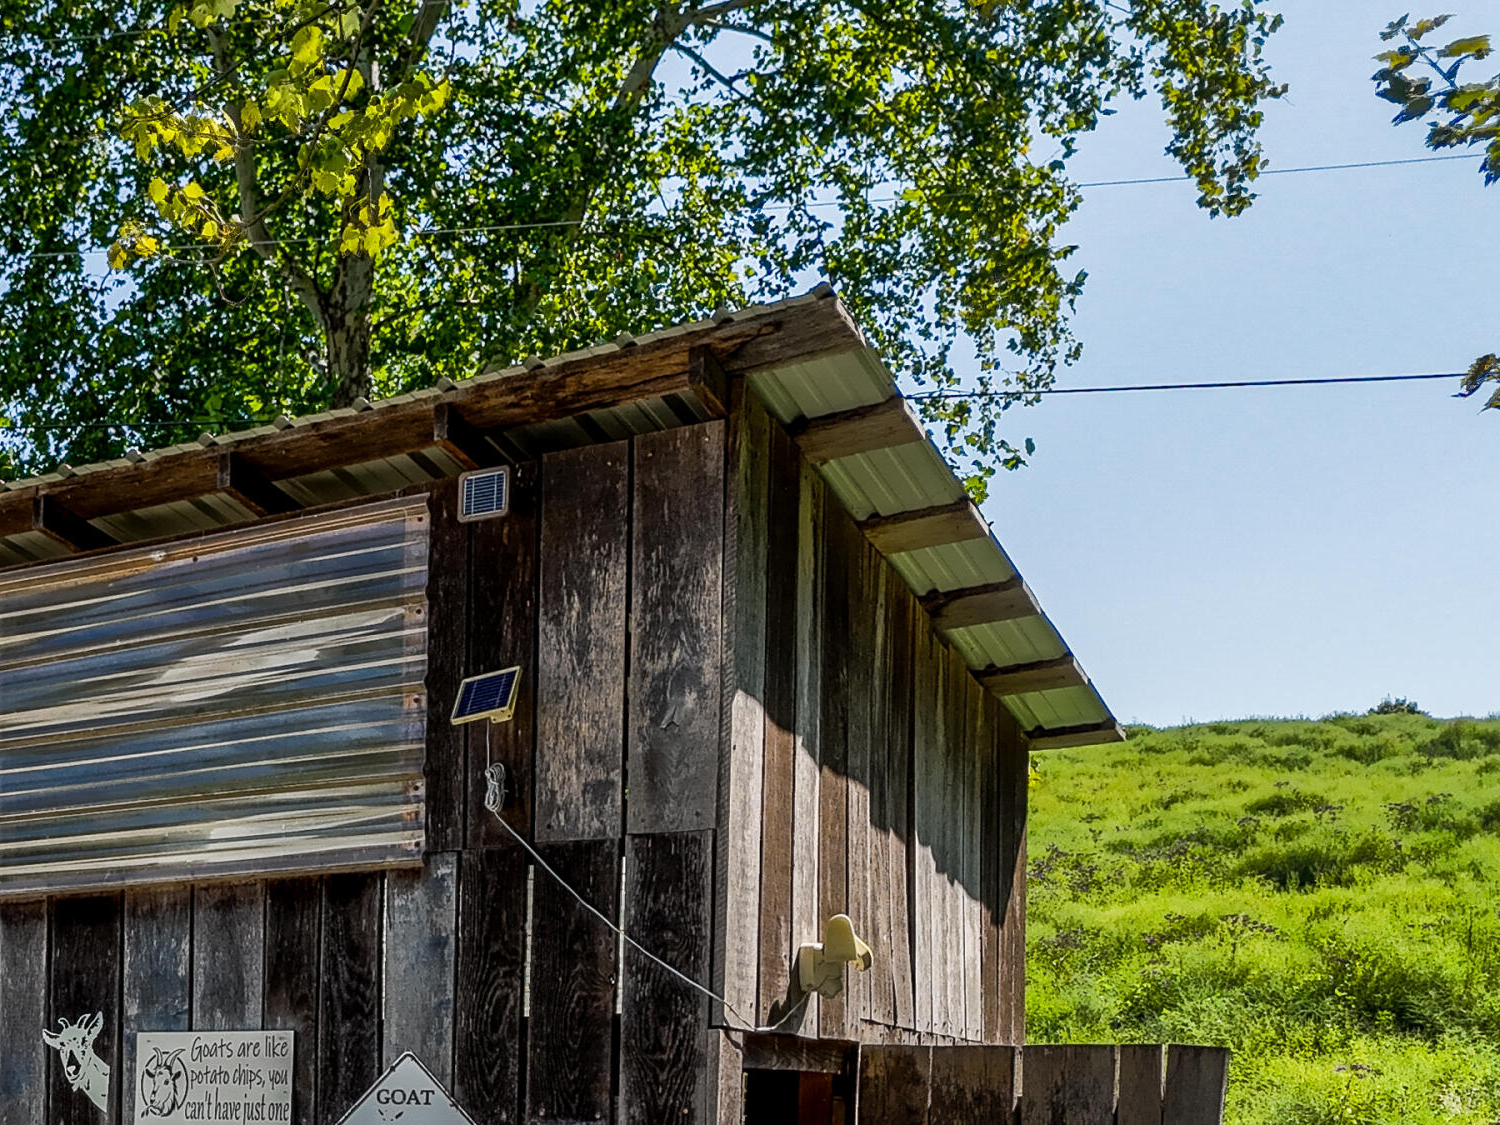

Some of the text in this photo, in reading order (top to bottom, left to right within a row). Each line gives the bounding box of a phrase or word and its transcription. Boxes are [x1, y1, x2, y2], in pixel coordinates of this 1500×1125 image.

[191, 1035, 288, 1063] Goats are like
[191, 1063, 288, 1090] potato chips, you
[184, 1090, 211, 1120] can't
[215, 1087, 241, 1121] have
[268, 1102, 289, 1121] one
[377, 1089, 435, 1105] GOAT
